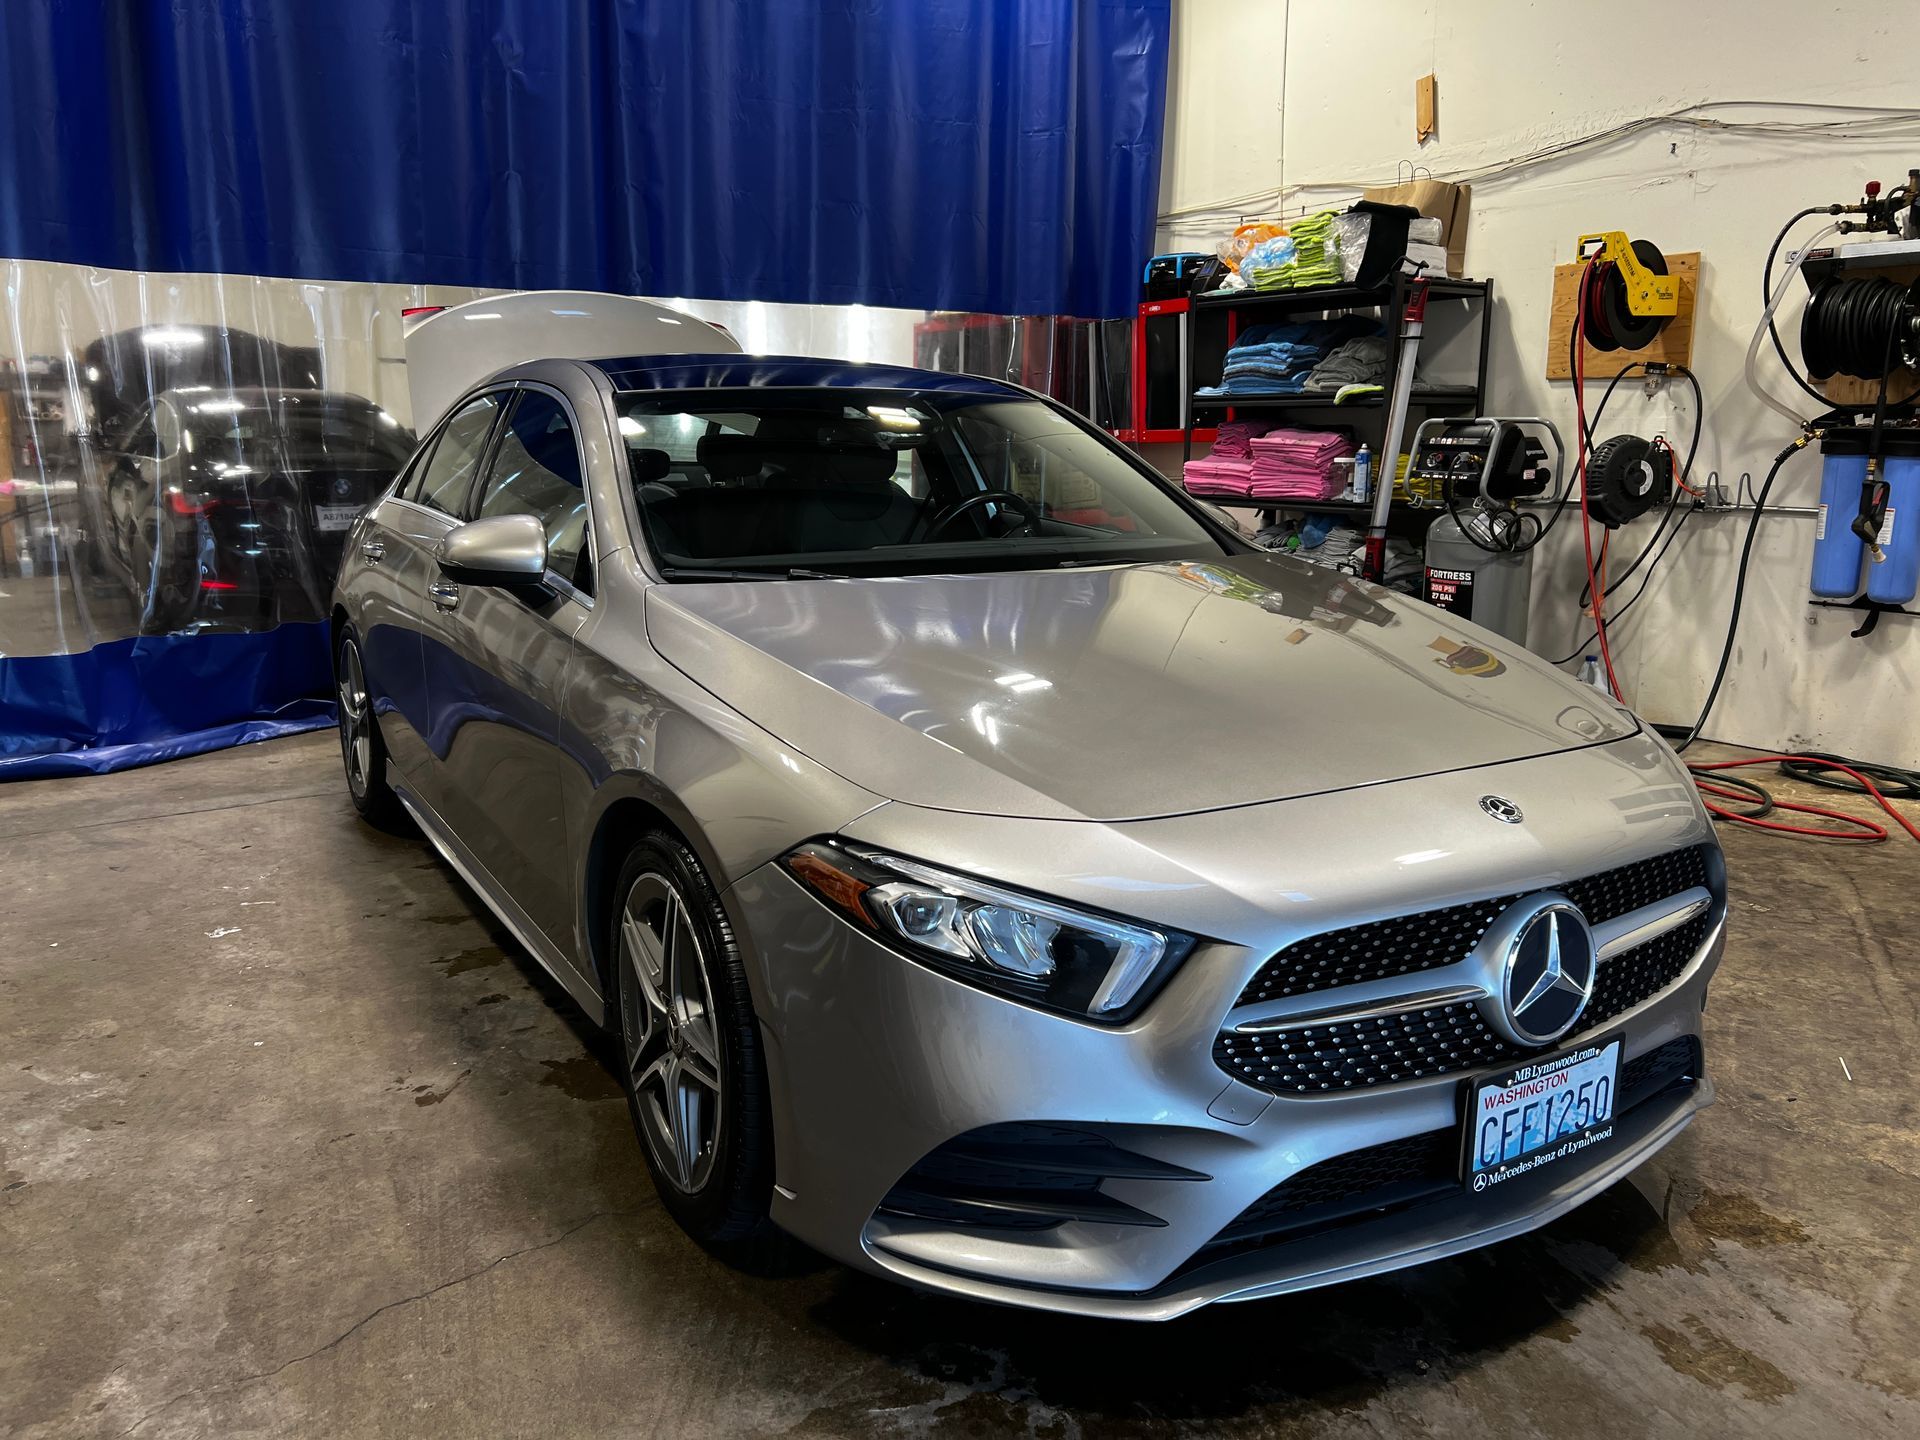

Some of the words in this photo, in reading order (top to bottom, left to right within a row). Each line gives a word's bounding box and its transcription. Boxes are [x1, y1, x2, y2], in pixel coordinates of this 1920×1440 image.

[1430, 569, 1472, 581] FORTRESS
[1431, 592, 1439, 600] 27
[1440, 593, 1453, 602] GAL
[1484, 1071, 1569, 1110] WASHINGTON
[1488, 1151, 1556, 1186] Mercedes-Benz
[1557, 1143, 1568, 1158] of
